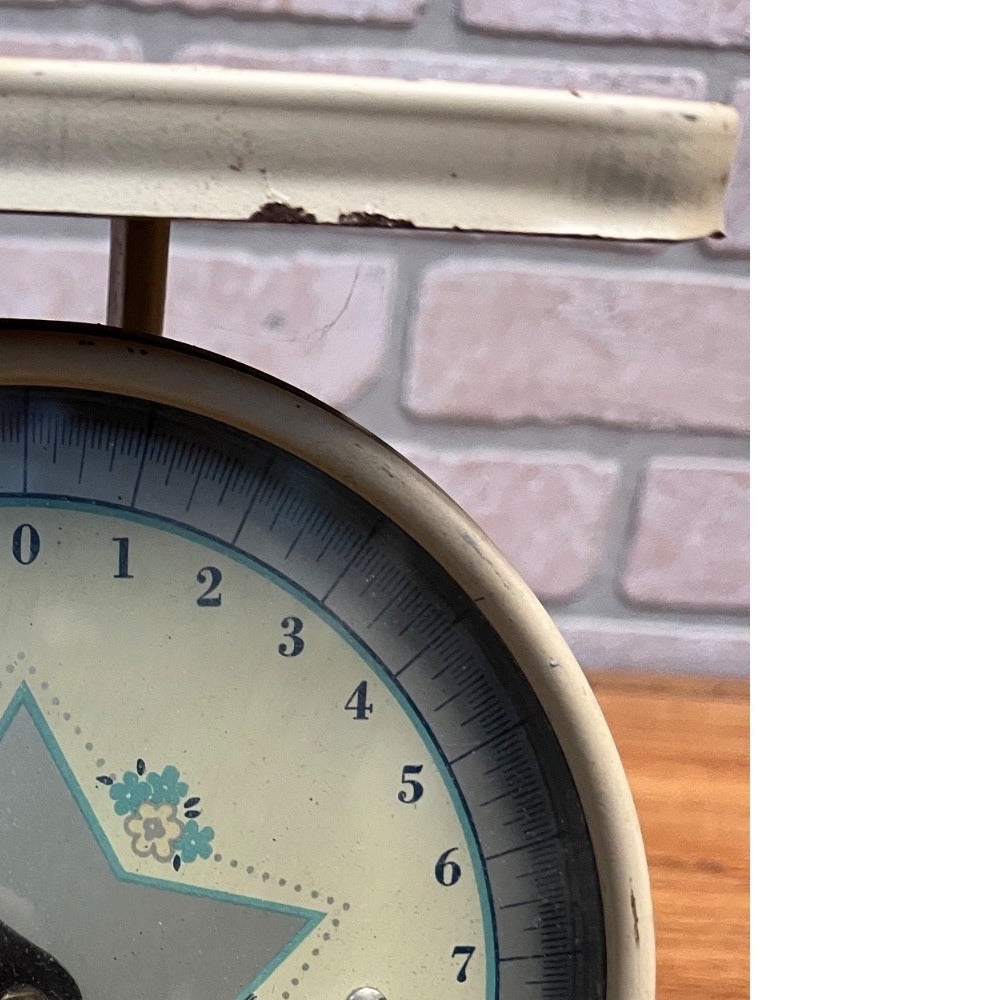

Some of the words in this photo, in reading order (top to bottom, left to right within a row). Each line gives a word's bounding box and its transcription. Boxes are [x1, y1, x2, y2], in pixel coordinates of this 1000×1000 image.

[13, 524, 40, 565] 0
[113, 538, 133, 578] 1
[197, 567, 221, 607] 2
[279, 617, 304, 657] 3
[345, 681, 372, 720] 4
[398, 765, 423, 804] 5
[435, 848, 461, 886] 6
[452, 946, 475, 982] 7
